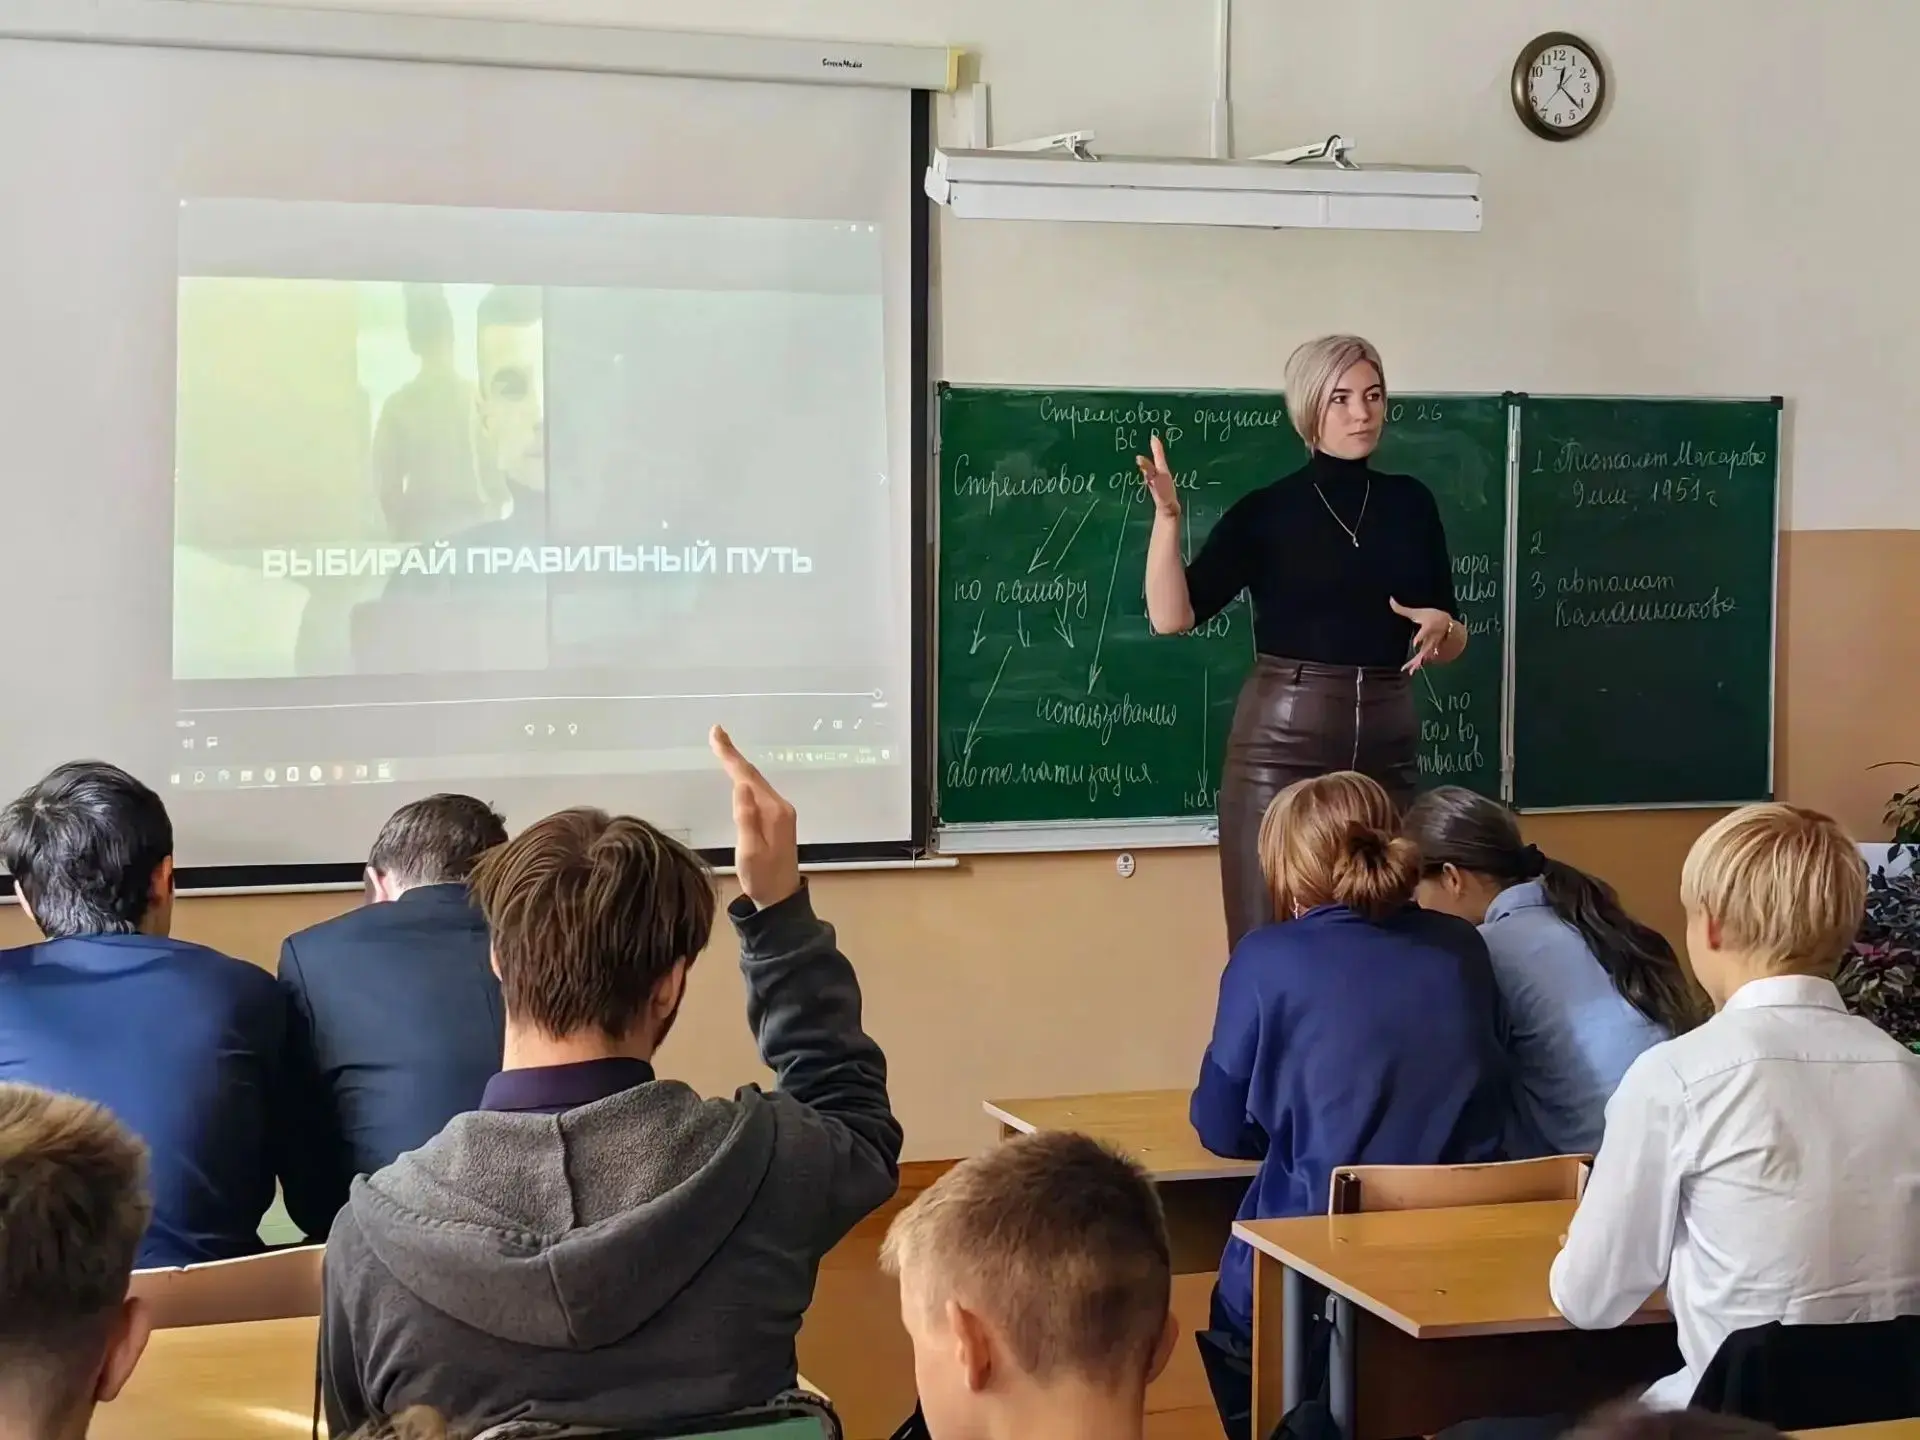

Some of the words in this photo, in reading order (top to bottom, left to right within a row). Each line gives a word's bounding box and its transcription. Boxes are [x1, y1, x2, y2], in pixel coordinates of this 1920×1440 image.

[1542, 54, 1551, 66] 11
[1553, 50, 1566, 61] 12
[1571, 55, 1576, 67] 1
[1531, 66, 1543, 78] 10
[1579, 67, 1587, 79] 2
[1583, 82, 1591, 94] 3
[1531, 95, 1538, 107] 8
[1554, 112, 1562, 125] 6
[1568, 109, 1576, 121] 5
[1041, 396, 1178, 440] Стрелковое
[954, 454, 1096, 516] Стрелковое
[1109, 469, 1201, 505] оруие
[262, 538, 456, 578] ВЫБИРАЙ
[467, 539, 716, 575] ПРАВИЛЬНЫЙ
[726, 546, 813, 574] ПУТЬ
[954, 579, 982, 600] по
